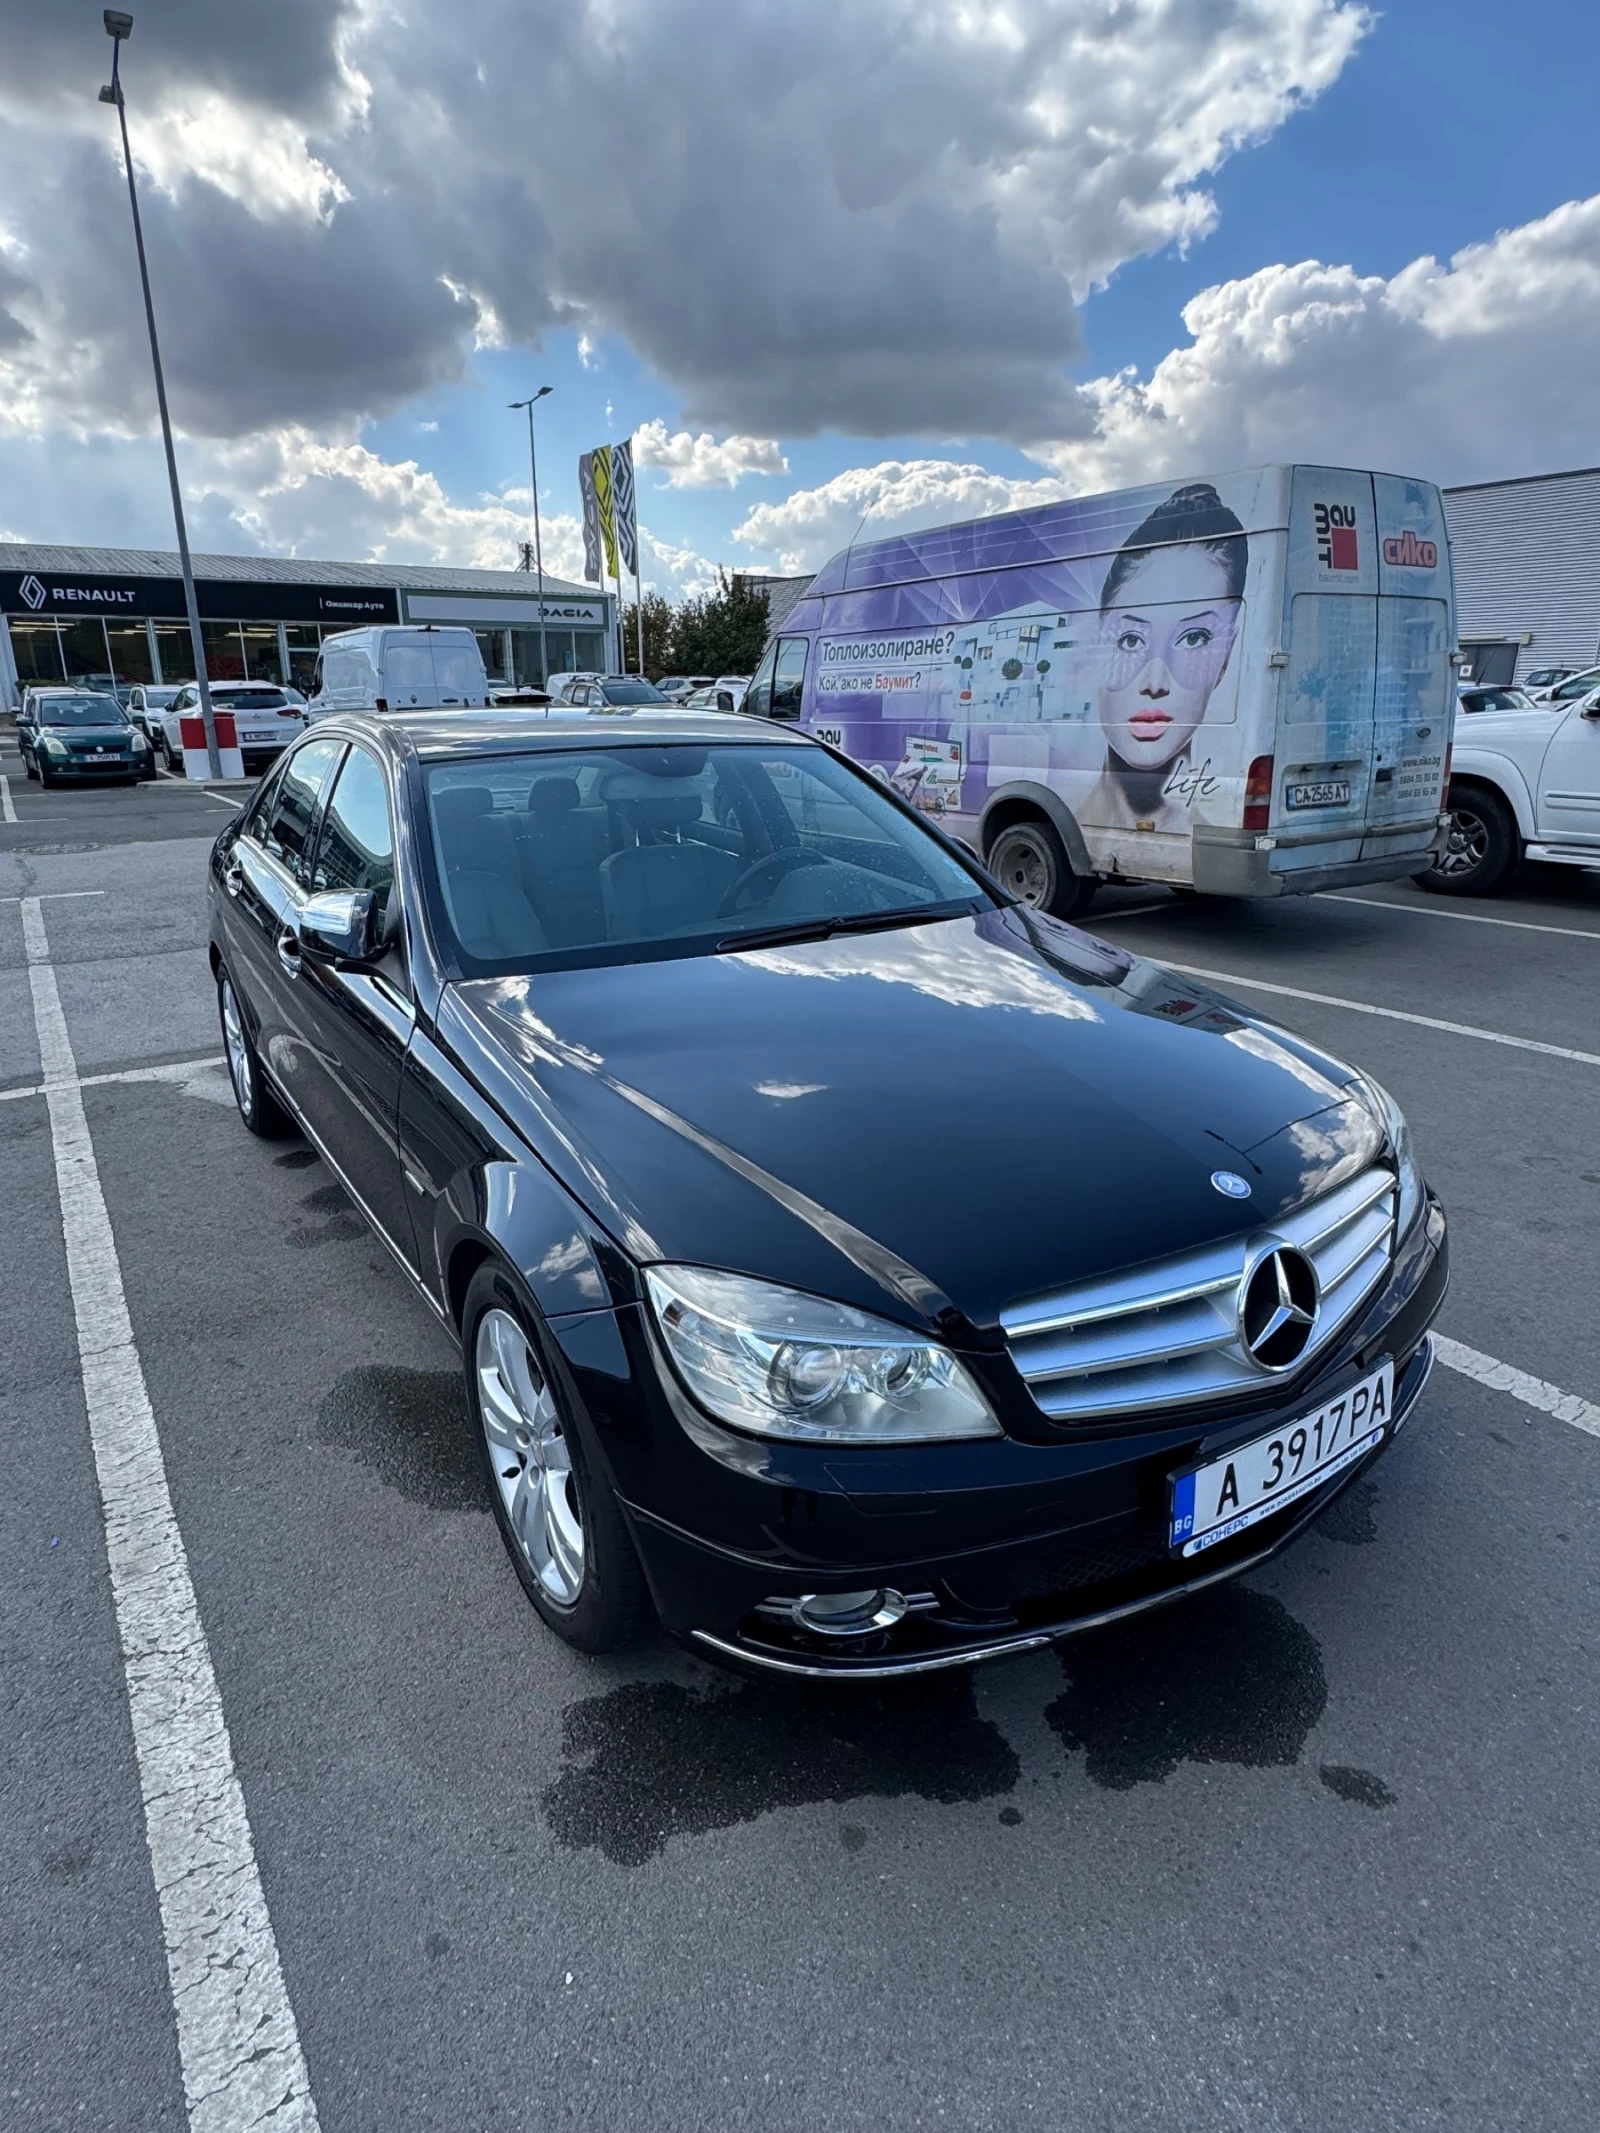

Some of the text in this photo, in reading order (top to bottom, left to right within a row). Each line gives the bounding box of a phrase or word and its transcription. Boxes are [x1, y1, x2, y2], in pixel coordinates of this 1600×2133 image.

[52, 588, 136, 603] RENAULT
[364, 601, 385, 611] Ауто
[537, 608, 594, 618] DACIA
[822, 631, 955, 662] Топлоизолиране?
[818, 671, 922, 693] Кой, ако не Баумит?
[1163, 757, 1221, 808] Life
[1215, 1461, 1240, 1517] A
[1174, 1514, 1193, 1536] BG
